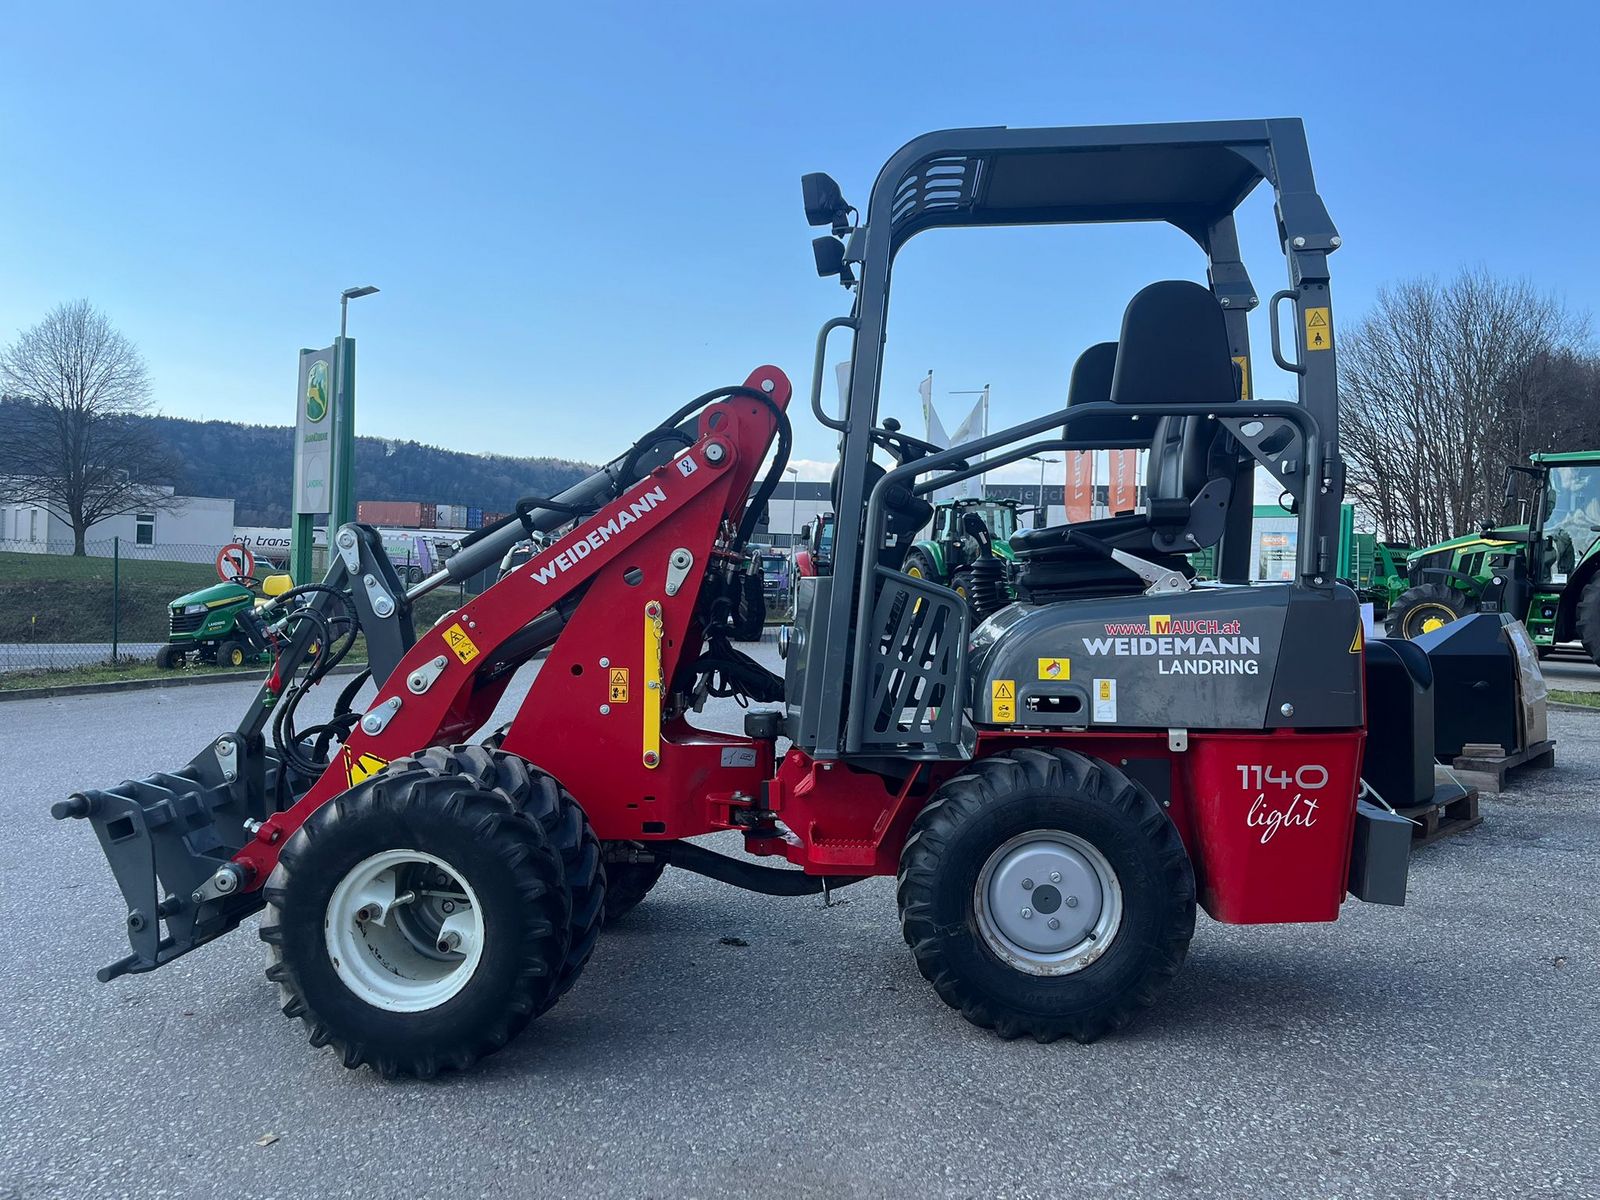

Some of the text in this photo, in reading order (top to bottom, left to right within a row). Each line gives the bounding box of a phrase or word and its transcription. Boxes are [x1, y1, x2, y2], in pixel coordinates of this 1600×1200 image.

[437, 511, 444, 521] K
[256, 535, 292, 547] trans
[530, 485, 667, 586] WEIDEMANN
[1104, 619, 1241, 636] www.MAUCH.at
[1082, 637, 1260, 655] WEIDEMANN
[1158, 659, 1259, 675] LANDRING
[1236, 764, 1329, 790] 1140
[1247, 792, 1320, 844] light
